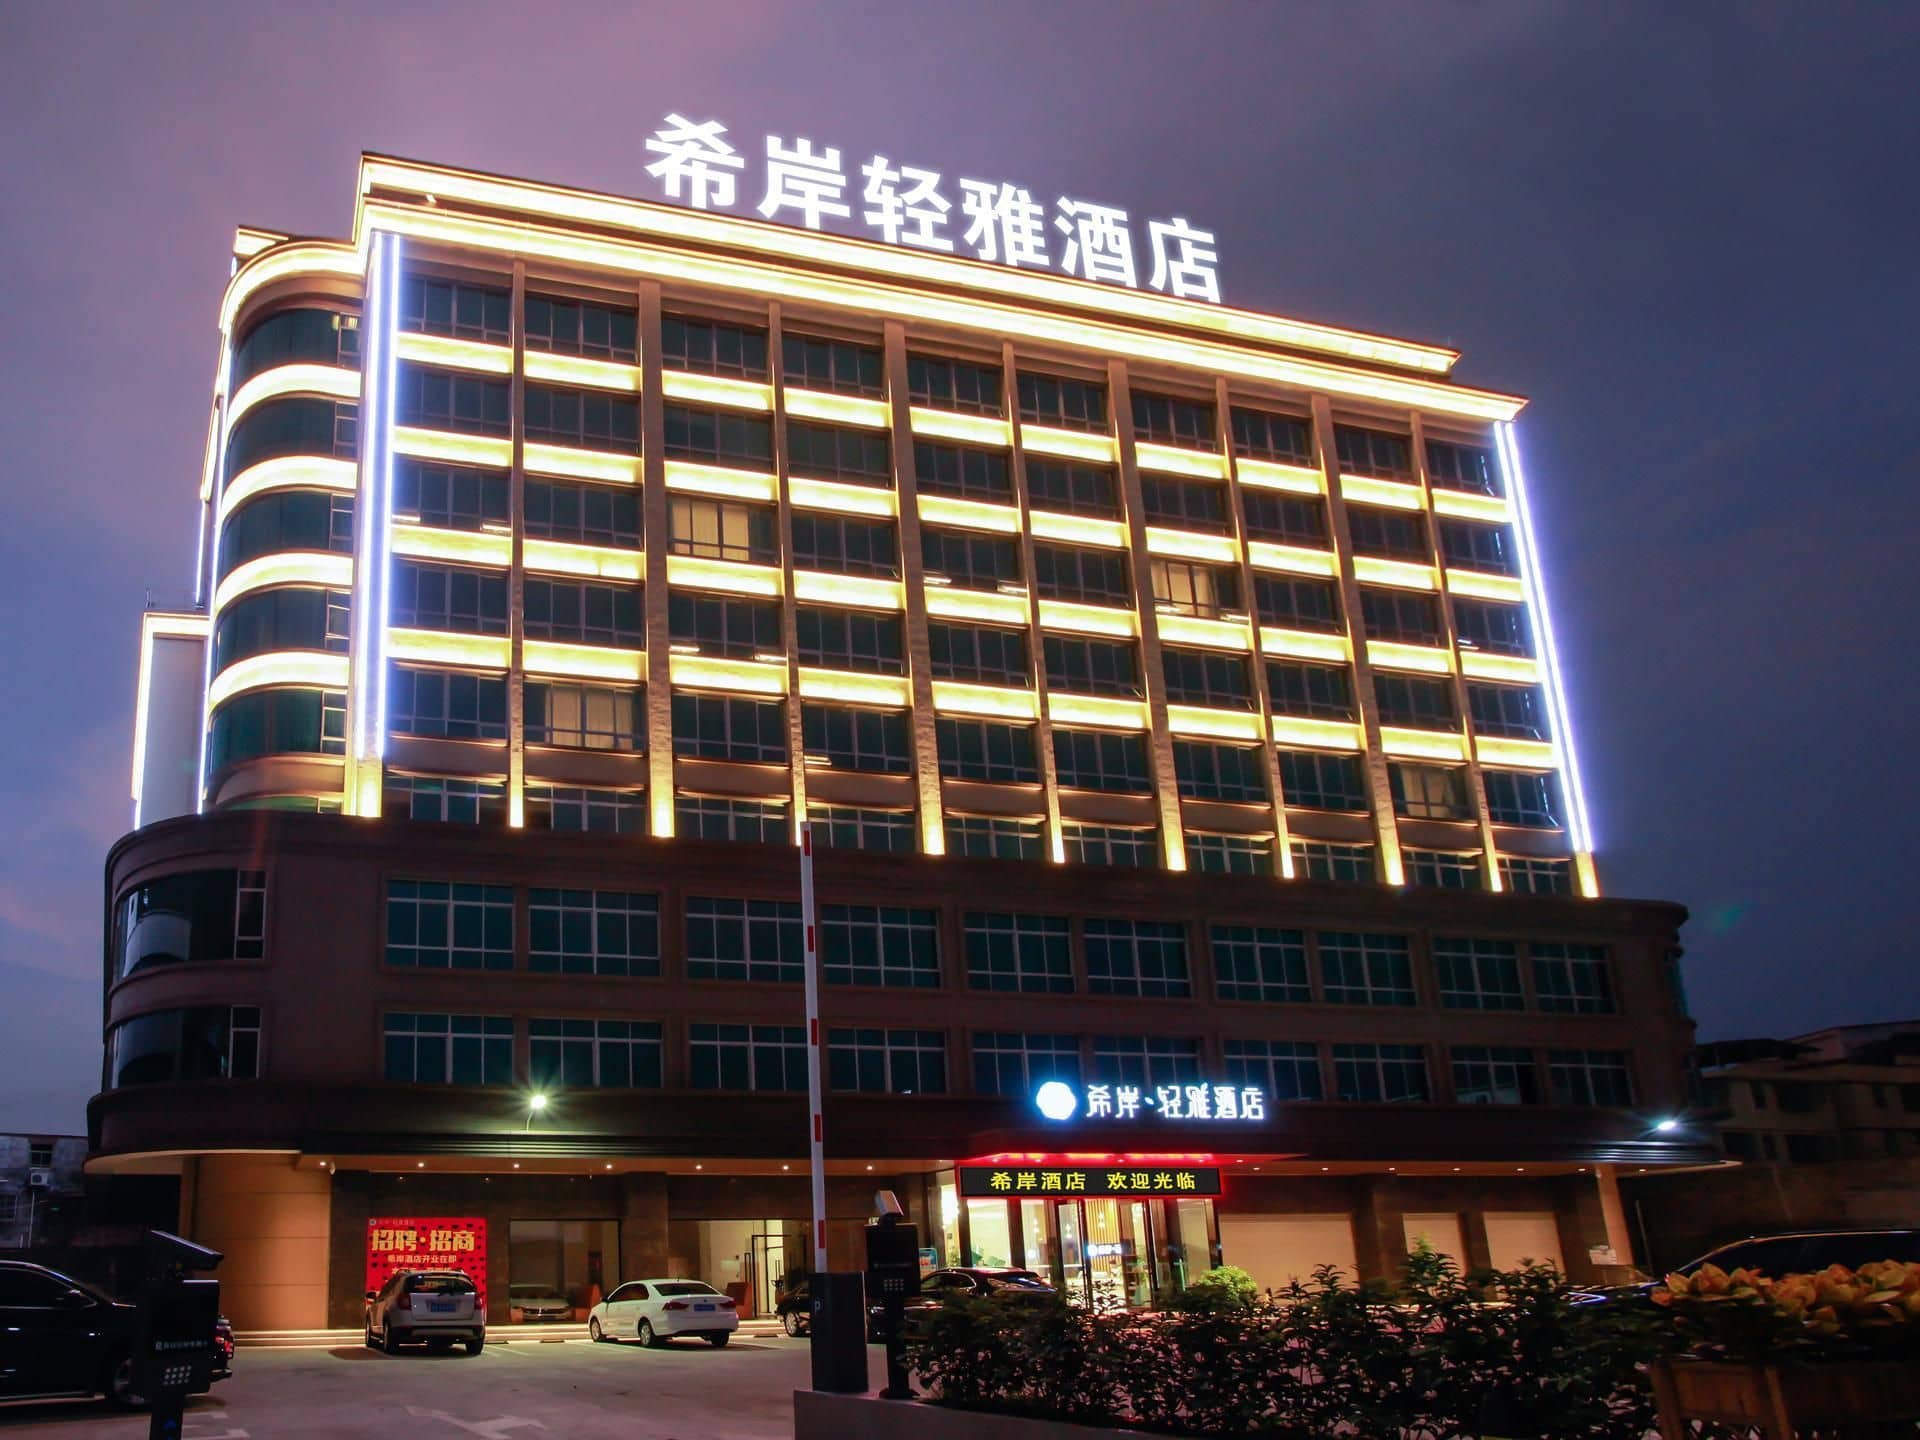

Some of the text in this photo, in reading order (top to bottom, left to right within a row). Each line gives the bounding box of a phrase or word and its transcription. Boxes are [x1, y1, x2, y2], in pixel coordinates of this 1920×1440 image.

[645, 113, 1222, 304] 希岸轻雅酒店
[990, 1171, 1196, 1191] 希岸酒店 欢迎光临
